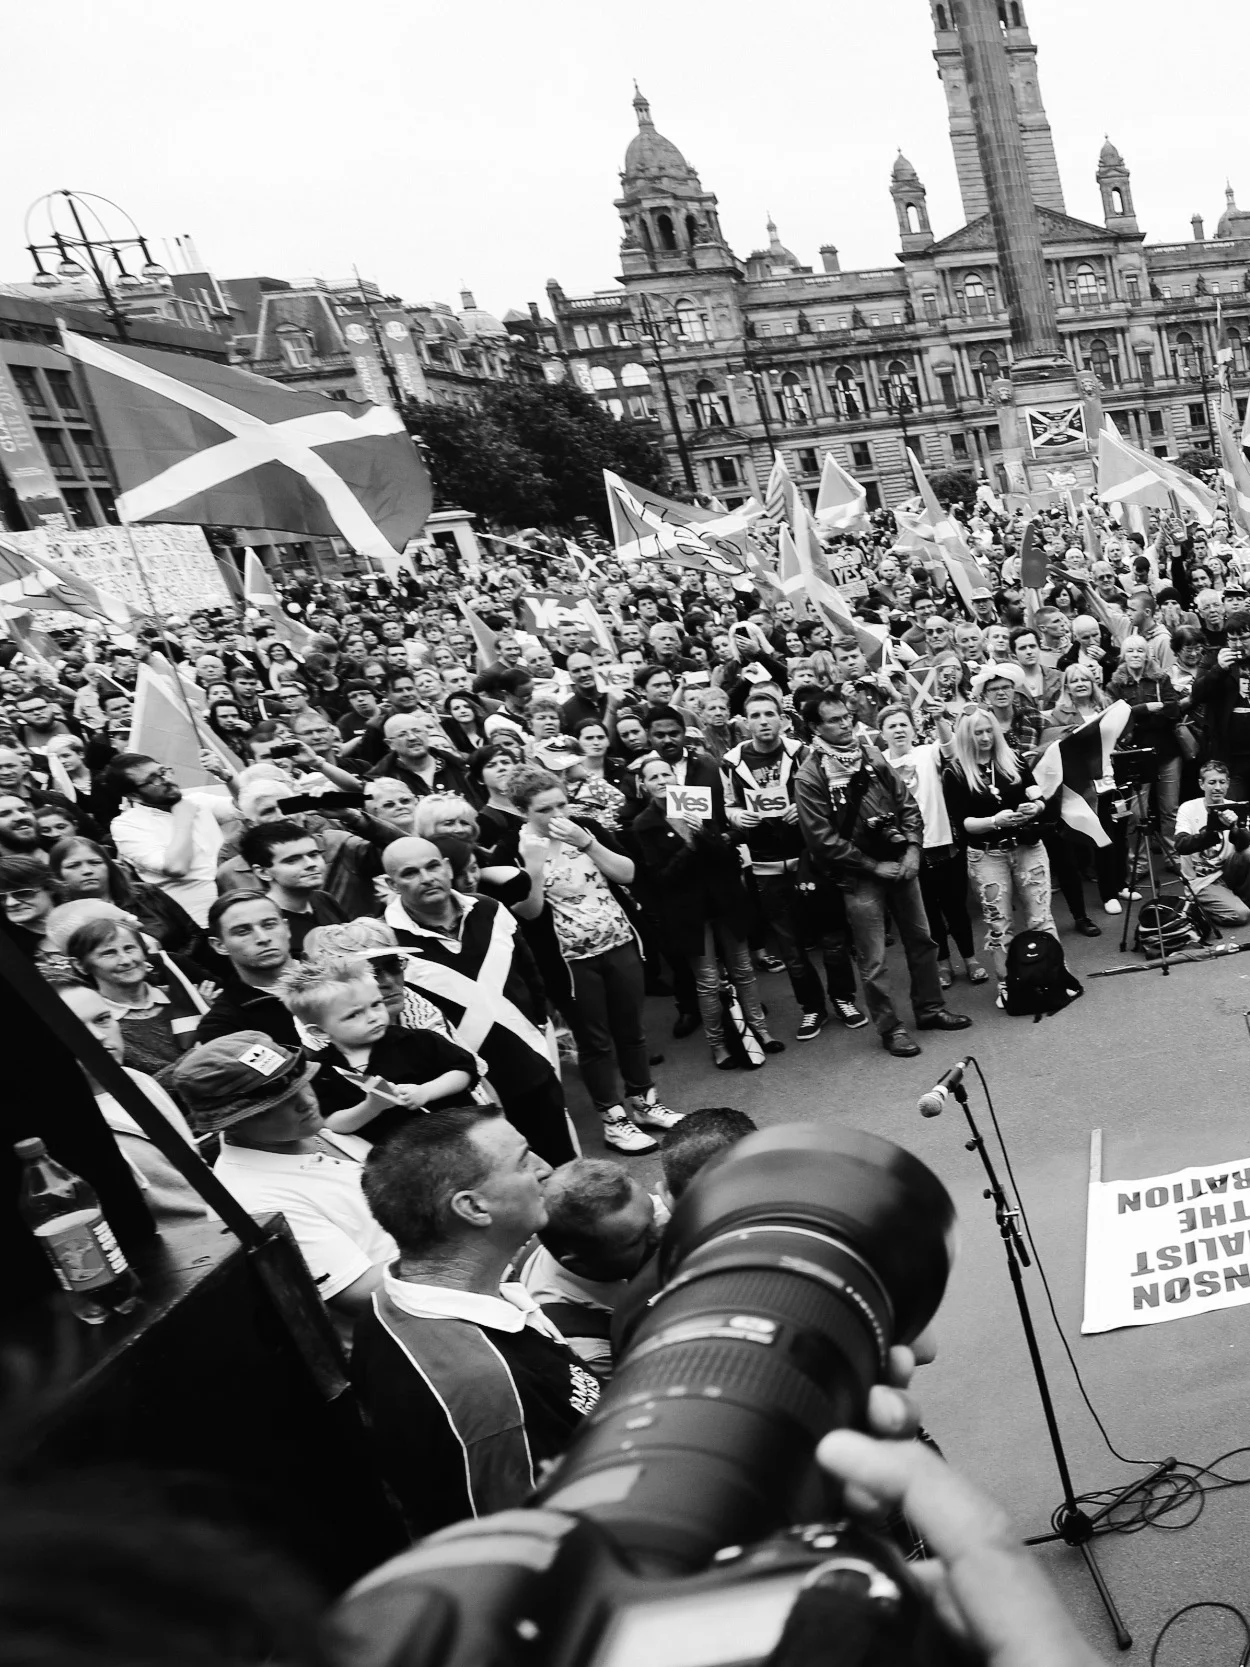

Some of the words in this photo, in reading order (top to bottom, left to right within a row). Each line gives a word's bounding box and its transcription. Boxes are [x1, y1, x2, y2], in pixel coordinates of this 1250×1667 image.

[831, 566, 861, 586] YES
[598, 670, 631, 686] Yes
[669, 791, 709, 812] Yes
[746, 793, 788, 813] Yes
